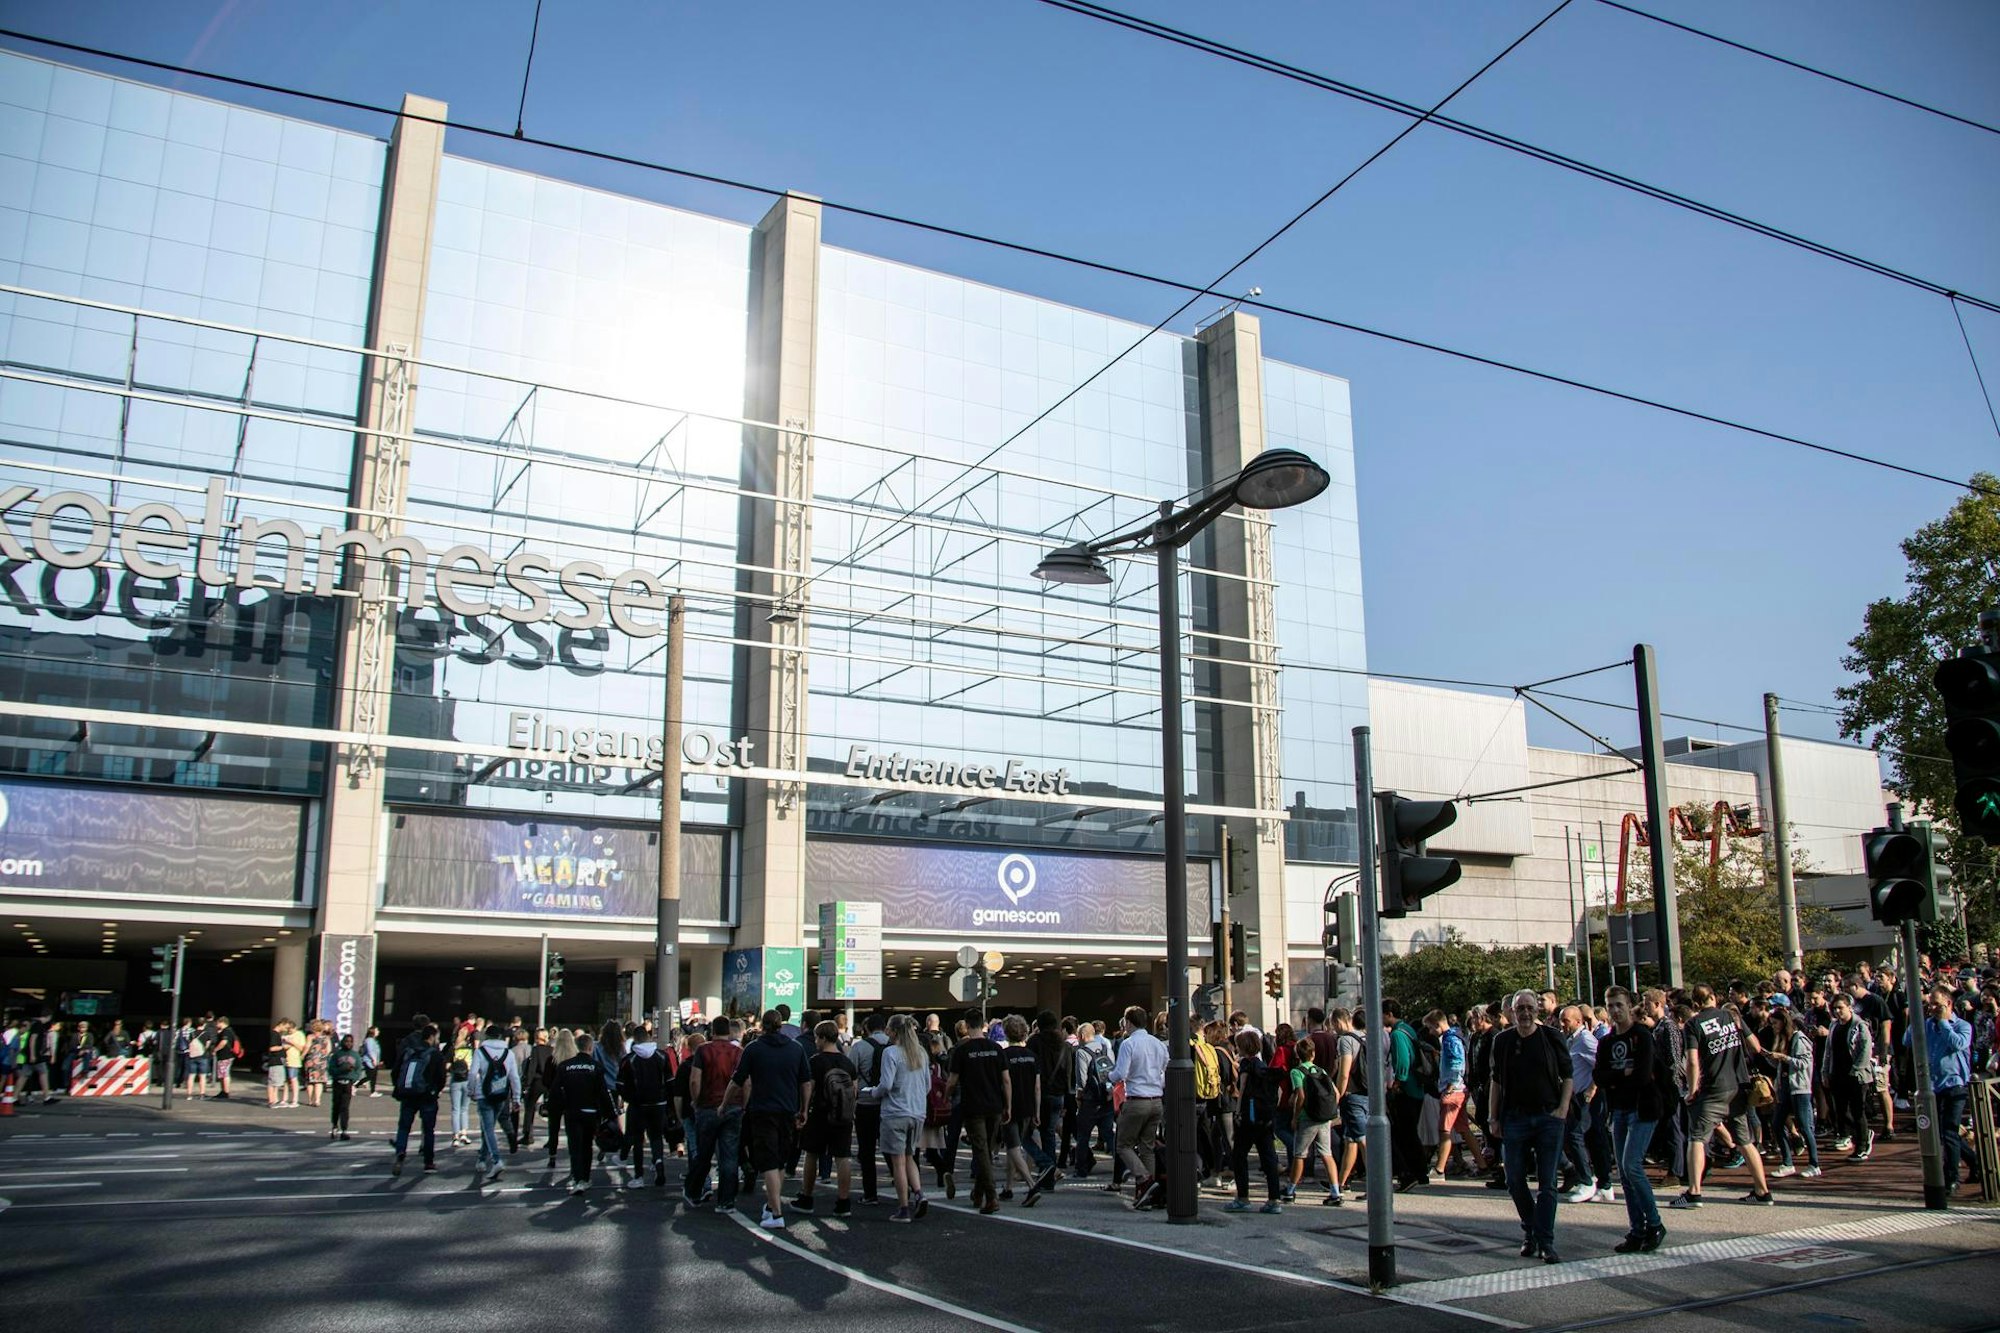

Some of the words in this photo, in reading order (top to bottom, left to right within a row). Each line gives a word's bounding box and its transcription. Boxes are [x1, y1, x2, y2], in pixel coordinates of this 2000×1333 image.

[508, 711, 664, 771] Eingang
[682, 729, 756, 769] Ost
[846, 744, 998, 789] Entrance
[1003, 759, 1071, 795] East
[512, 853, 618, 889] HEART
[532, 892, 604, 910] GAMING
[972, 907, 1061, 926] gamescom
[335, 939, 358, 1039] mescom
[768, 981, 801, 990] PLANET
[775, 988, 794, 996] ZOO
[1700, 1017, 1721, 1035] E3
